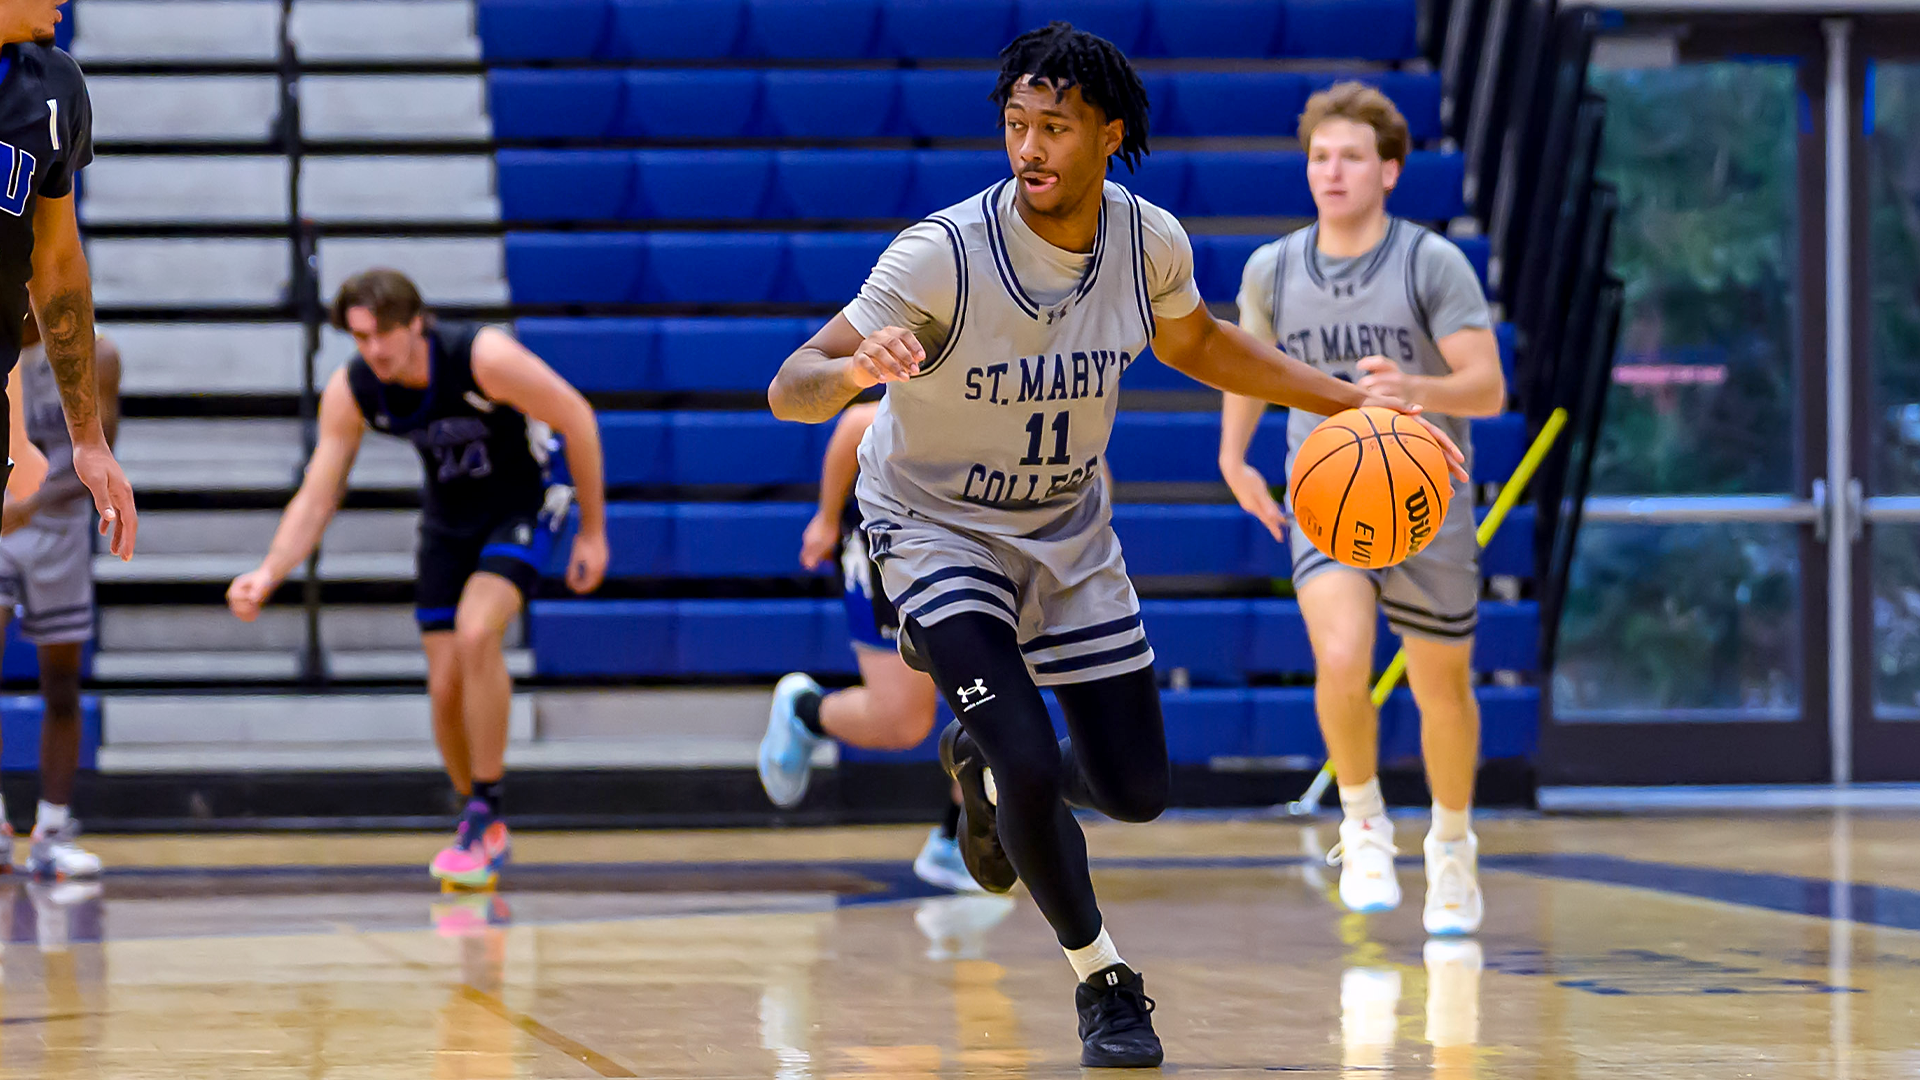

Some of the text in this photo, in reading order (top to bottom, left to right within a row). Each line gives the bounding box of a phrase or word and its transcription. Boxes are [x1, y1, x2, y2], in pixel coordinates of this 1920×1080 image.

[1320, 322, 1414, 363] MARY'S
[964, 363, 1010, 406] ST.
[1018, 410, 1071, 466] 11
[1404, 484, 1432, 558] Wils
